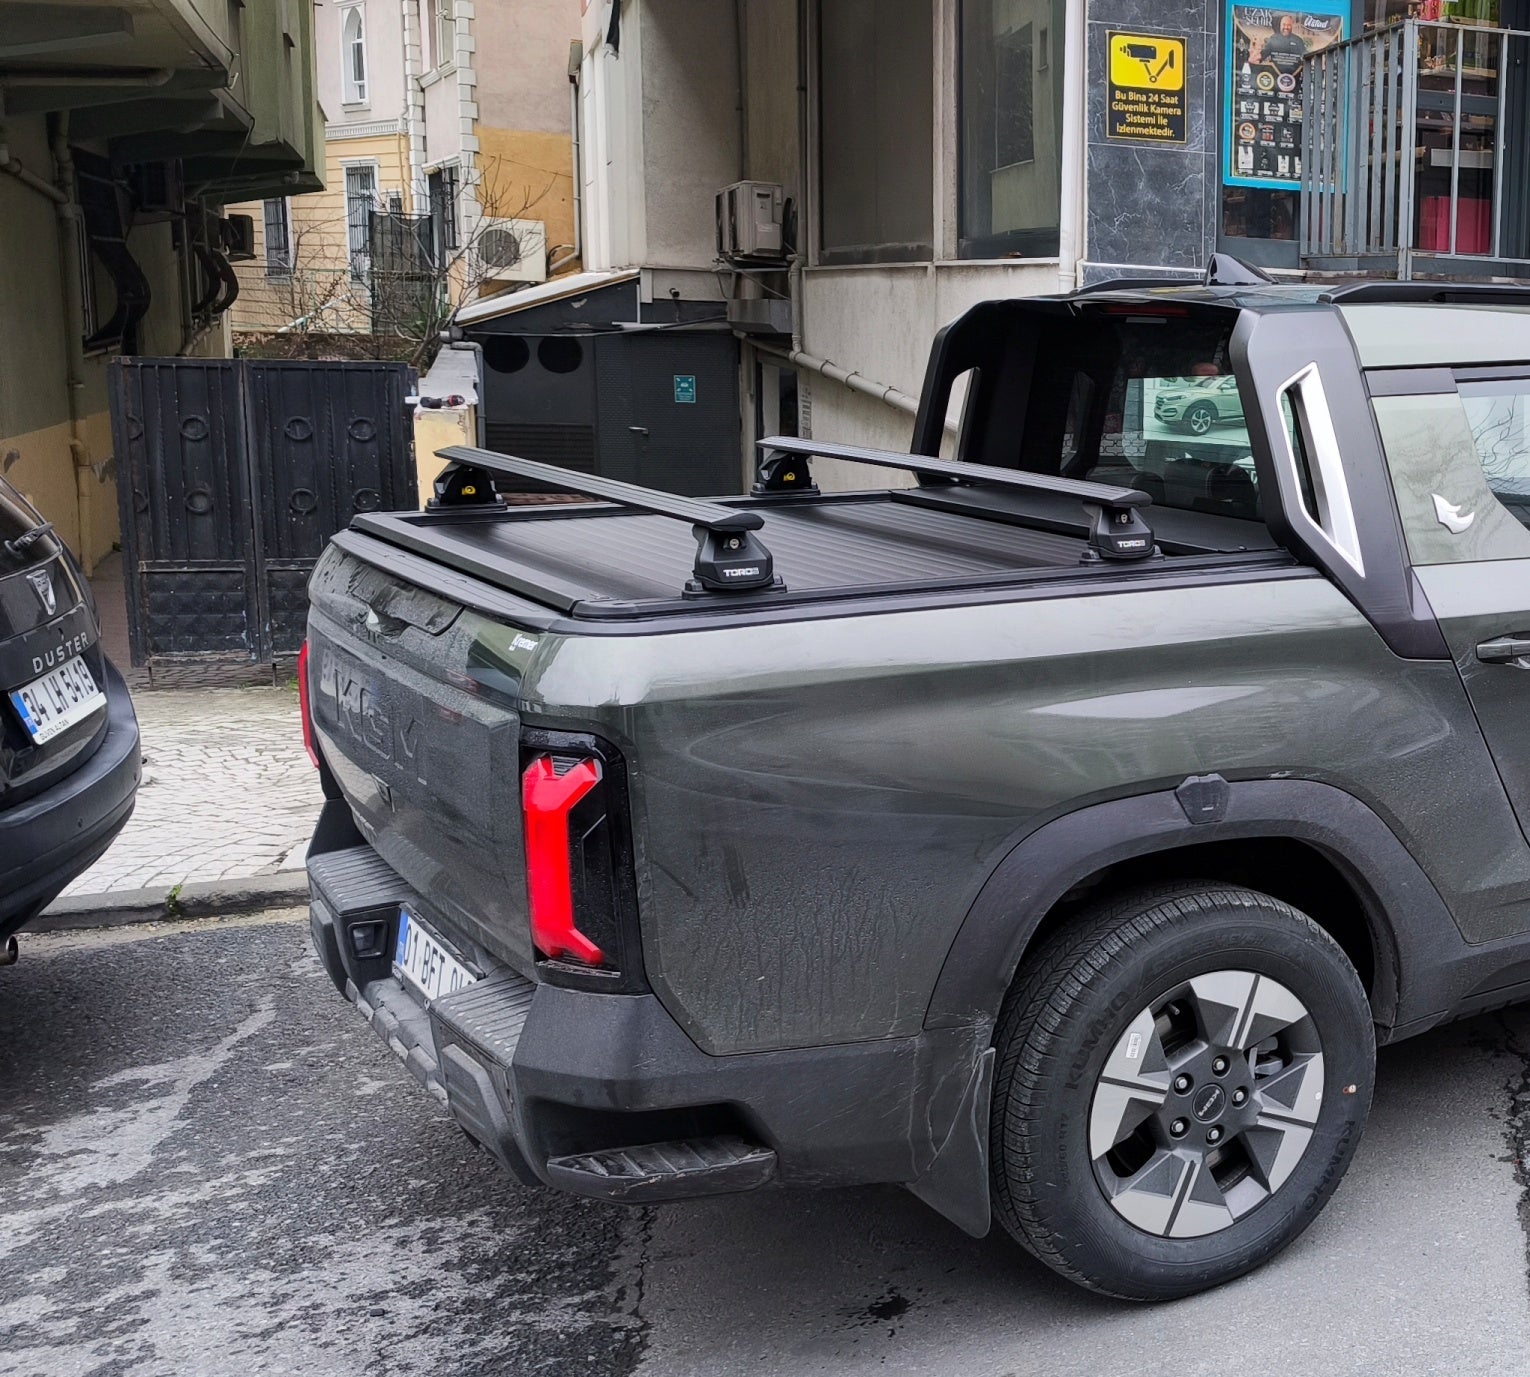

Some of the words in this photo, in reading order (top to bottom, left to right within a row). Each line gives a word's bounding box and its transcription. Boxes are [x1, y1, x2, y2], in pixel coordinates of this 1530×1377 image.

[1111, 101, 1149, 113] Güvenlik
[1150, 104, 1182, 116] Kamera
[1115, 90, 1126, 100] Bu
[1128, 91, 1147, 102] Bina
[1148, 93, 1159, 103] 24
[1160, 94, 1179, 105] Saat
[1125, 113, 1156, 125] Sistemi
[32, 631, 89, 674] DUSTER
[22, 688, 51, 727] 34
[42, 675, 70, 715] LH
[59, 659, 95, 703] 5419
[420, 939, 446, 998] BFT
